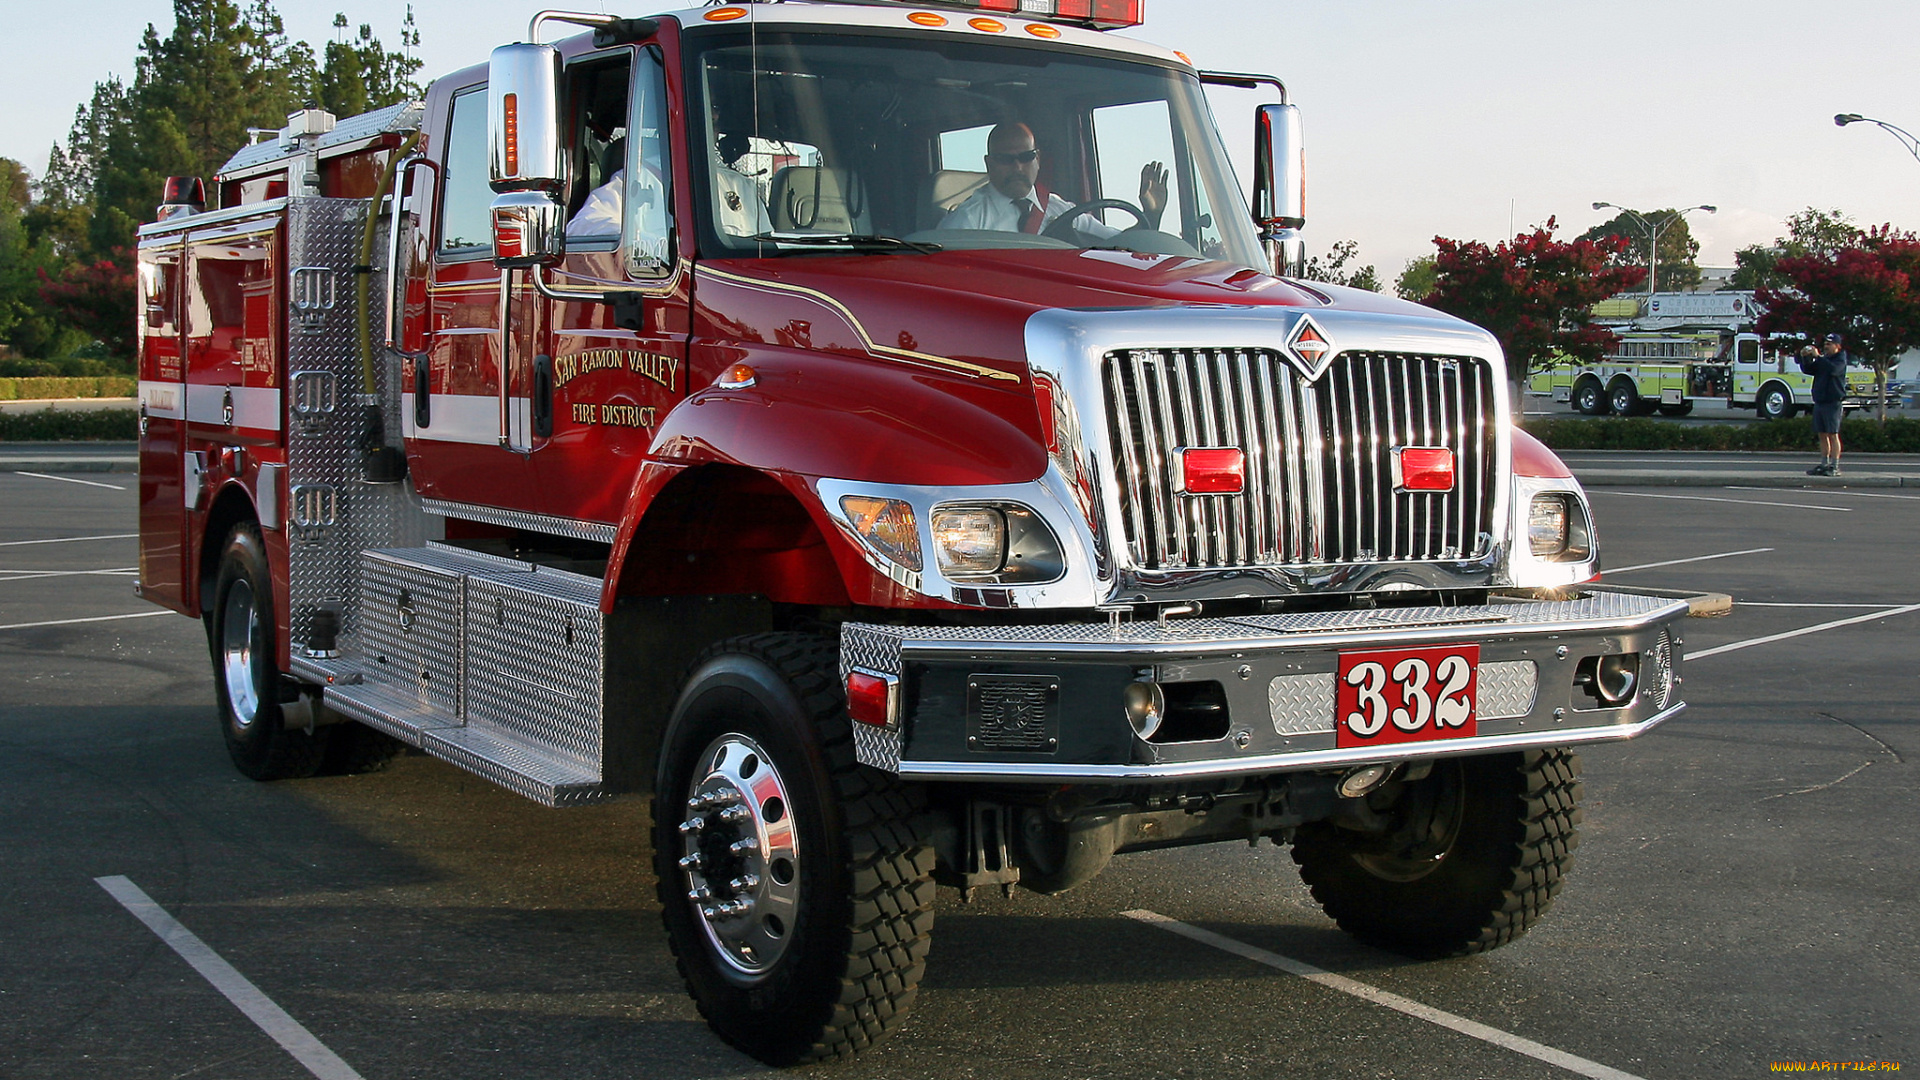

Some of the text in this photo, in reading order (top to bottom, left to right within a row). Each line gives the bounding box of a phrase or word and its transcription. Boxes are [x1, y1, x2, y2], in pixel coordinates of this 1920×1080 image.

[632, 238, 668, 258] FDNY
[554, 349, 679, 393] SAN RAMON VALLEY
[572, 403, 656, 428] FIRE DISTRICT
[1346, 655, 1472, 739] 332
